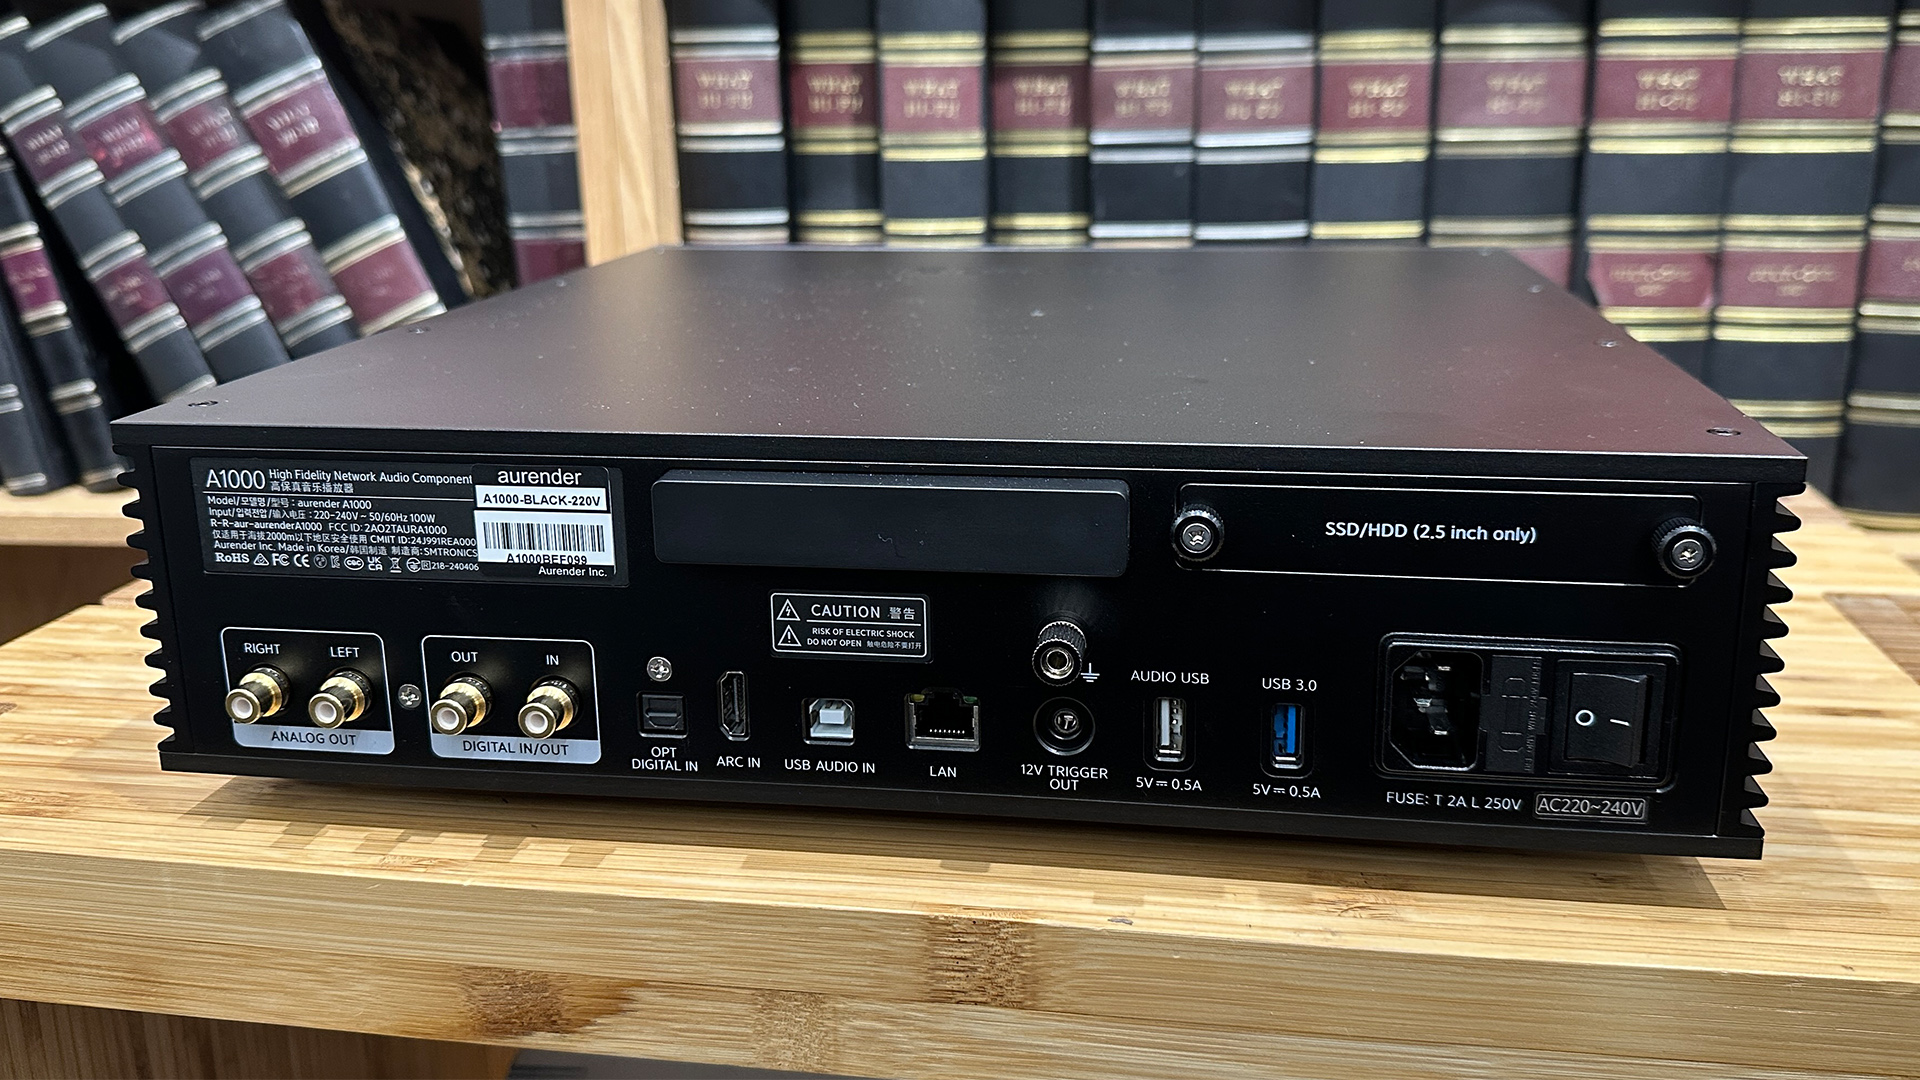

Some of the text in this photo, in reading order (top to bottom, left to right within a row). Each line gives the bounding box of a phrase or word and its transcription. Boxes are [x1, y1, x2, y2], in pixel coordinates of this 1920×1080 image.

[206, 469, 473, 490] A1000 High Fidelity Network Audio Component
[498, 468, 582, 485] aurender
[270, 481, 354, 494] 高保真音乐播放器
[297, 499, 341, 509] aurender
[343, 500, 372, 510] A1000
[483, 493, 601, 507] A1000-BLACK-220V
[369, 512, 408, 523] 50/60Hz
[410, 513, 436, 523] 100W
[211, 519, 323, 531] R-R-aur-aurenderA1000
[329, 523, 349, 532] FCC
[370, 535, 396, 544] CMIIT
[1325, 522, 1537, 545] SSD/HDD (2.5 inch only)
[214, 540, 256, 551] Aurender
[260, 542, 277, 552] Inc.
[279, 543, 305, 553] Made
[307, 543, 316, 553] in
[215, 552, 250, 563] RoHS
[432, 562, 480, 571] 218-240406
[538, 566, 608, 577] Aurender Inc.
[811, 604, 881, 619] CAUTION
[812, 627, 915, 639] RISK OF ELECTRIC SHOCK
[244, 642, 281, 655] RIGHT
[807, 638, 820, 646] DO
[821, 638, 838, 647] NOT
[840, 639, 862, 648] OPEN
[330, 646, 360, 658] LEFT
[451, 651, 479, 663] OUT
[546, 654, 560, 666] IN
[1130, 669, 1210, 685] AUDIO USB
[1262, 677, 1318, 692] USB 3.0
[271, 730, 357, 746] ANALOG OUT
[463, 740, 570, 756] DIGITAL IN/OUT
[651, 746, 678, 759] OPT
[631, 758, 699, 773] DIGITAL IN
[716, 755, 762, 769] ARC IN
[784, 758, 876, 774] USB AUDIO IN
[930, 765, 958, 779] LAN
[1020, 763, 1109, 780] 12V TRIGGER
[1049, 779, 1080, 792] OUT
[1171, 778, 1203, 792] 0.5A
[1289, 785, 1322, 799] 0.5A
[1385, 791, 1523, 811] FUSE: T 2A L 250V
[1537, 798, 1645, 817] AC220~240V
